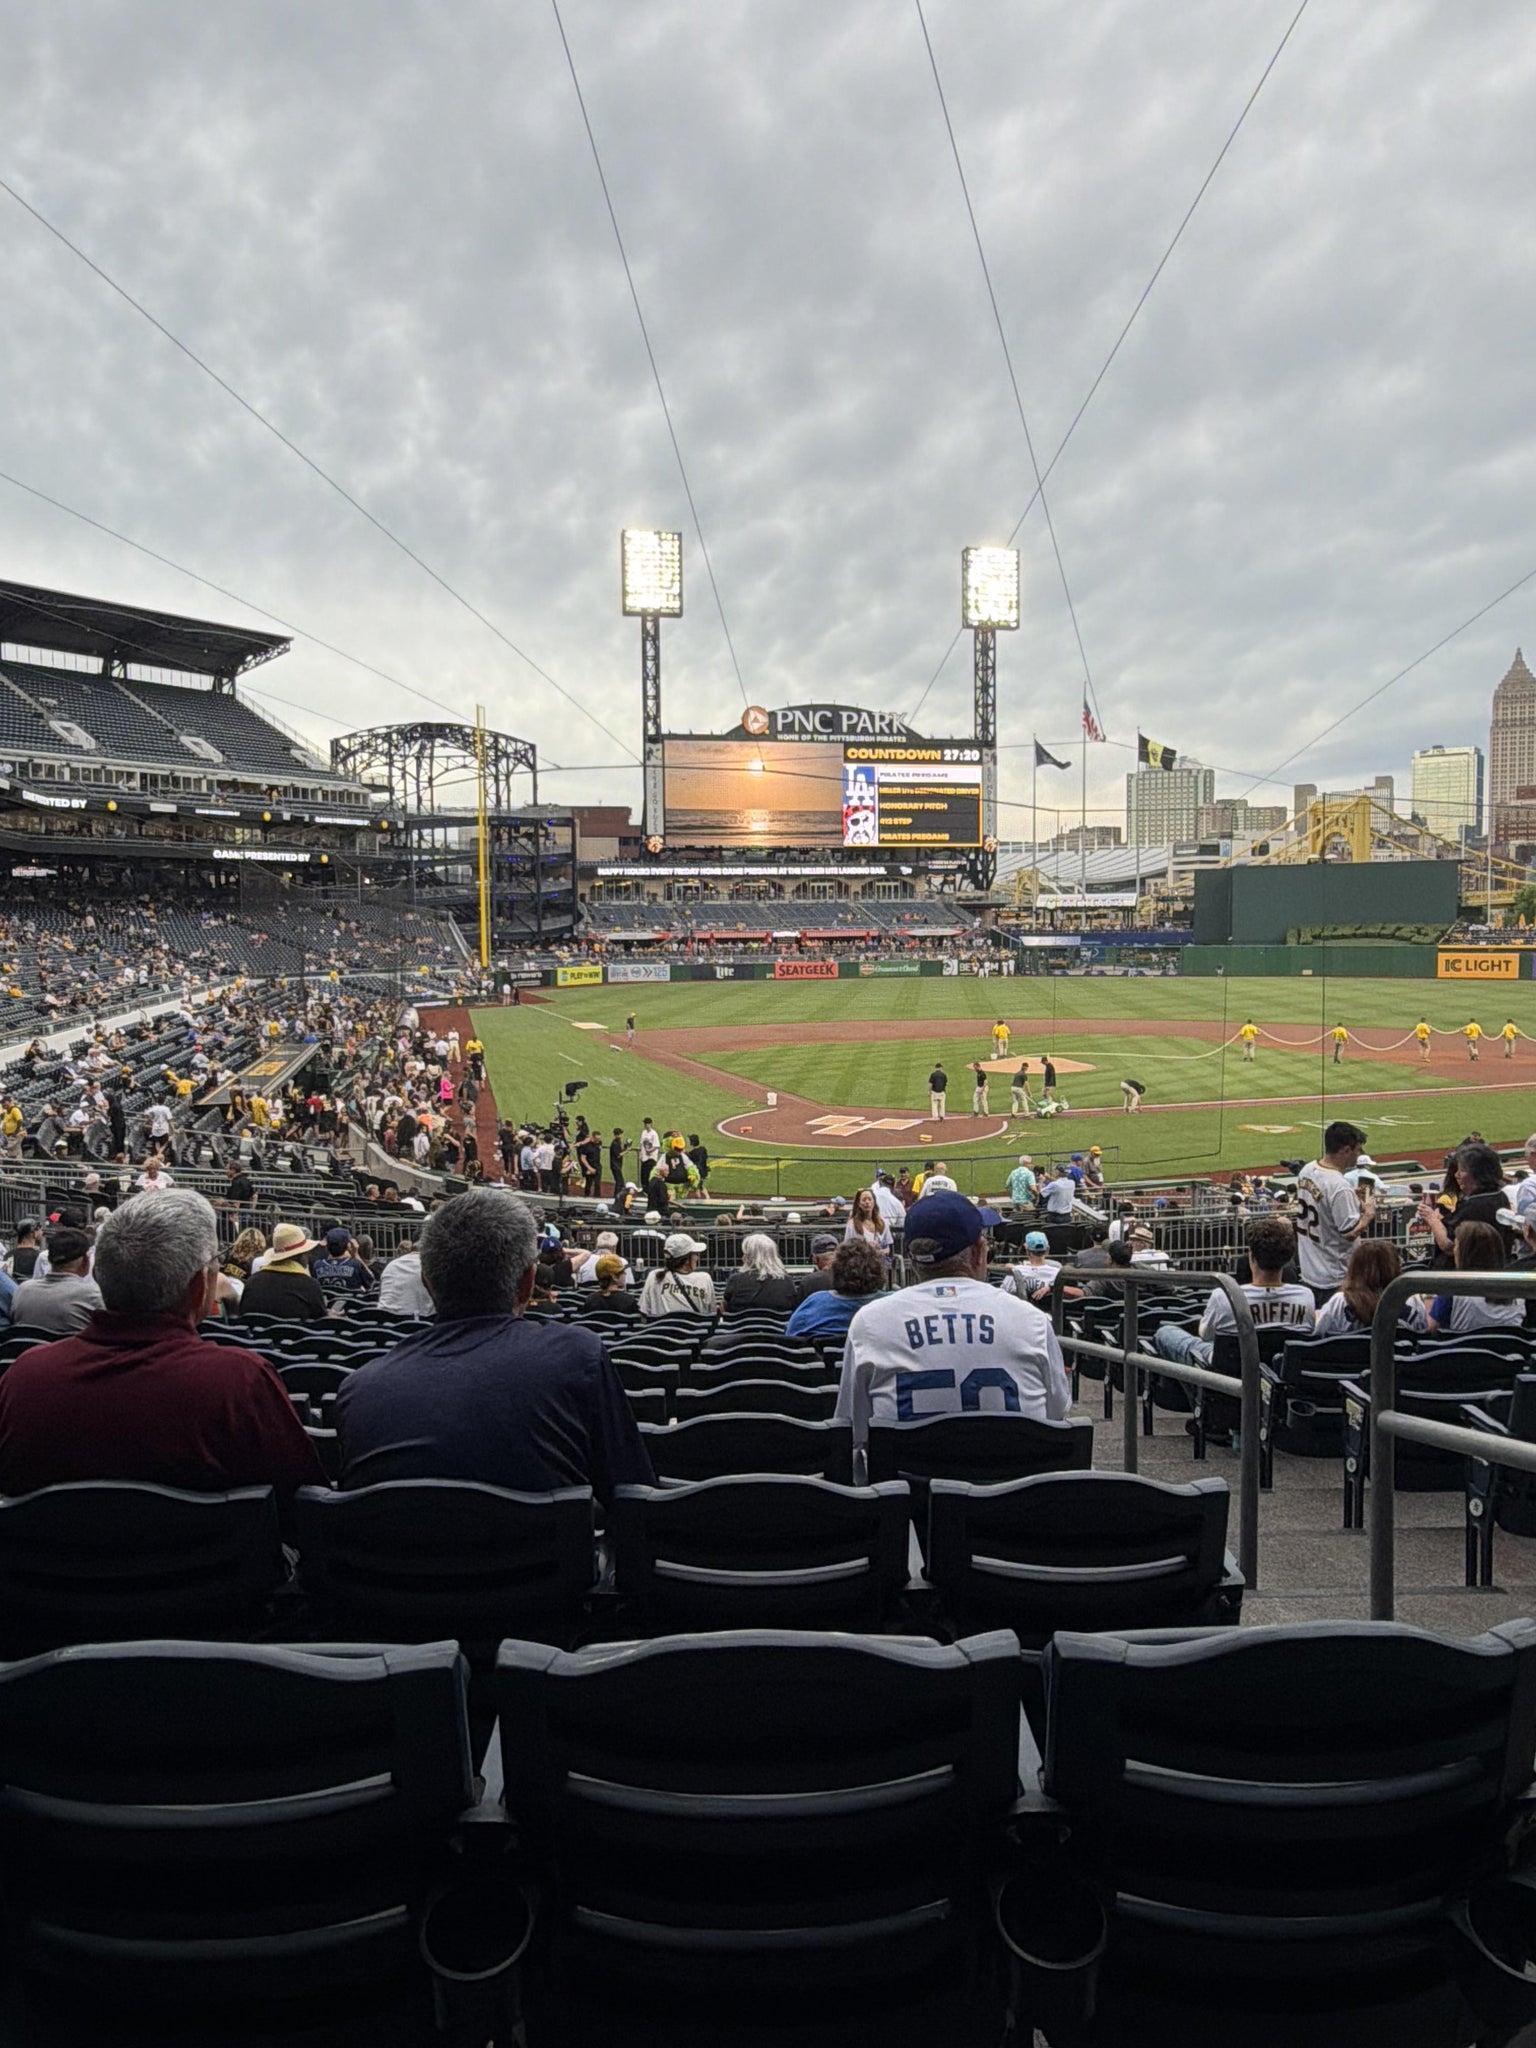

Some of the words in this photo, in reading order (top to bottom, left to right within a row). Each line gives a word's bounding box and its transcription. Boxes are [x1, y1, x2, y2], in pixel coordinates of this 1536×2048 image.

[776, 710, 833, 733] PNC
[839, 711, 908, 734] PARK
[777, 733, 799, 741] HOME
[846, 748, 942, 760] COUNTDOWN
[943, 749, 980, 761] 27:20
[71, 799, 88, 809] BY
[879, 802, 923, 810] HONORARY
[924, 802, 948, 810] PITCH
[879, 833, 911, 841] PIRATES
[244, 851, 298, 862] PRESENTED
[298, 853, 311, 862] BY
[597, 867, 624, 876] HAPPY
[778, 964, 834, 976] SEATGEEK
[1445, 959, 1462, 972] IC
[1465, 959, 1512, 972] LIGHT
[570, 971, 583, 980] PLAY
[661, 1282, 706, 1300] PIRTES
[1249, 1301, 1306, 1325] RIFFIN
[904, 1313, 996, 1350] BETTS
